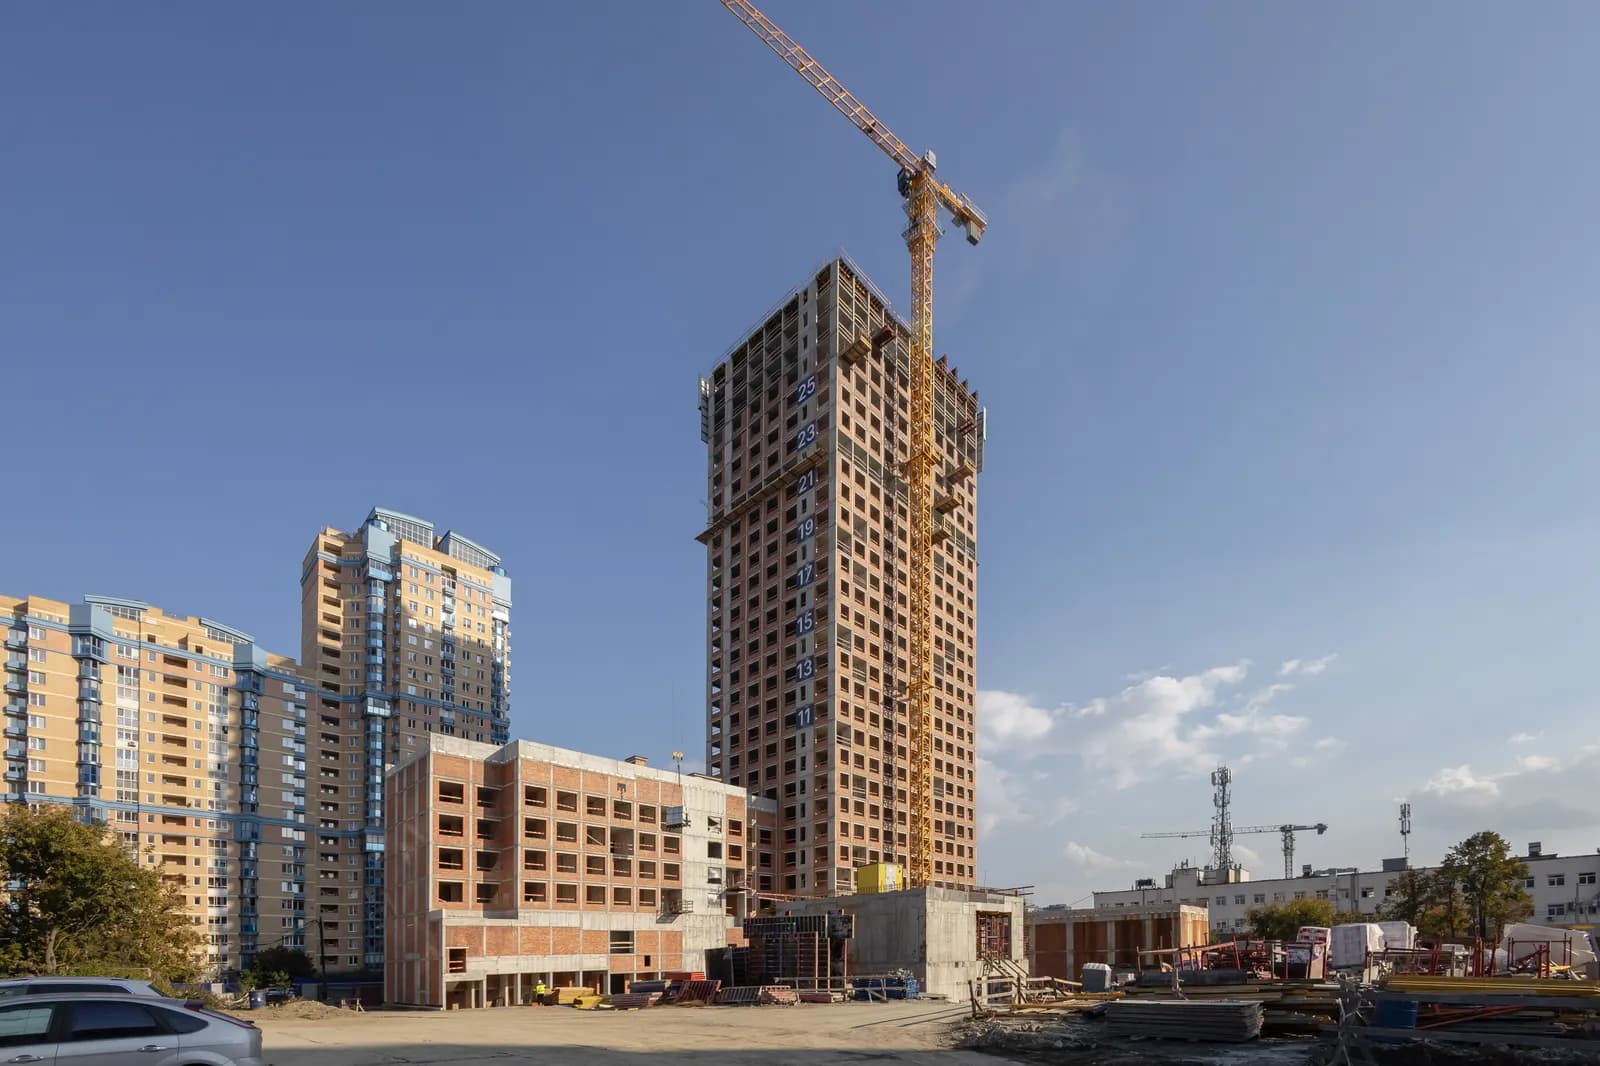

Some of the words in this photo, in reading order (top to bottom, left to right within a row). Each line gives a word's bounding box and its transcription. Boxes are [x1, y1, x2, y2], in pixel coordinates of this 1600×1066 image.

[798, 375, 815, 402] 25
[798, 424, 815, 449] 23
[798, 470, 813, 493] 21
[798, 519, 813, 540] 19
[797, 564, 812, 585] 17
[797, 612, 812, 632] 15
[797, 660, 812, 679] 13
[798, 708, 811, 726] 11
